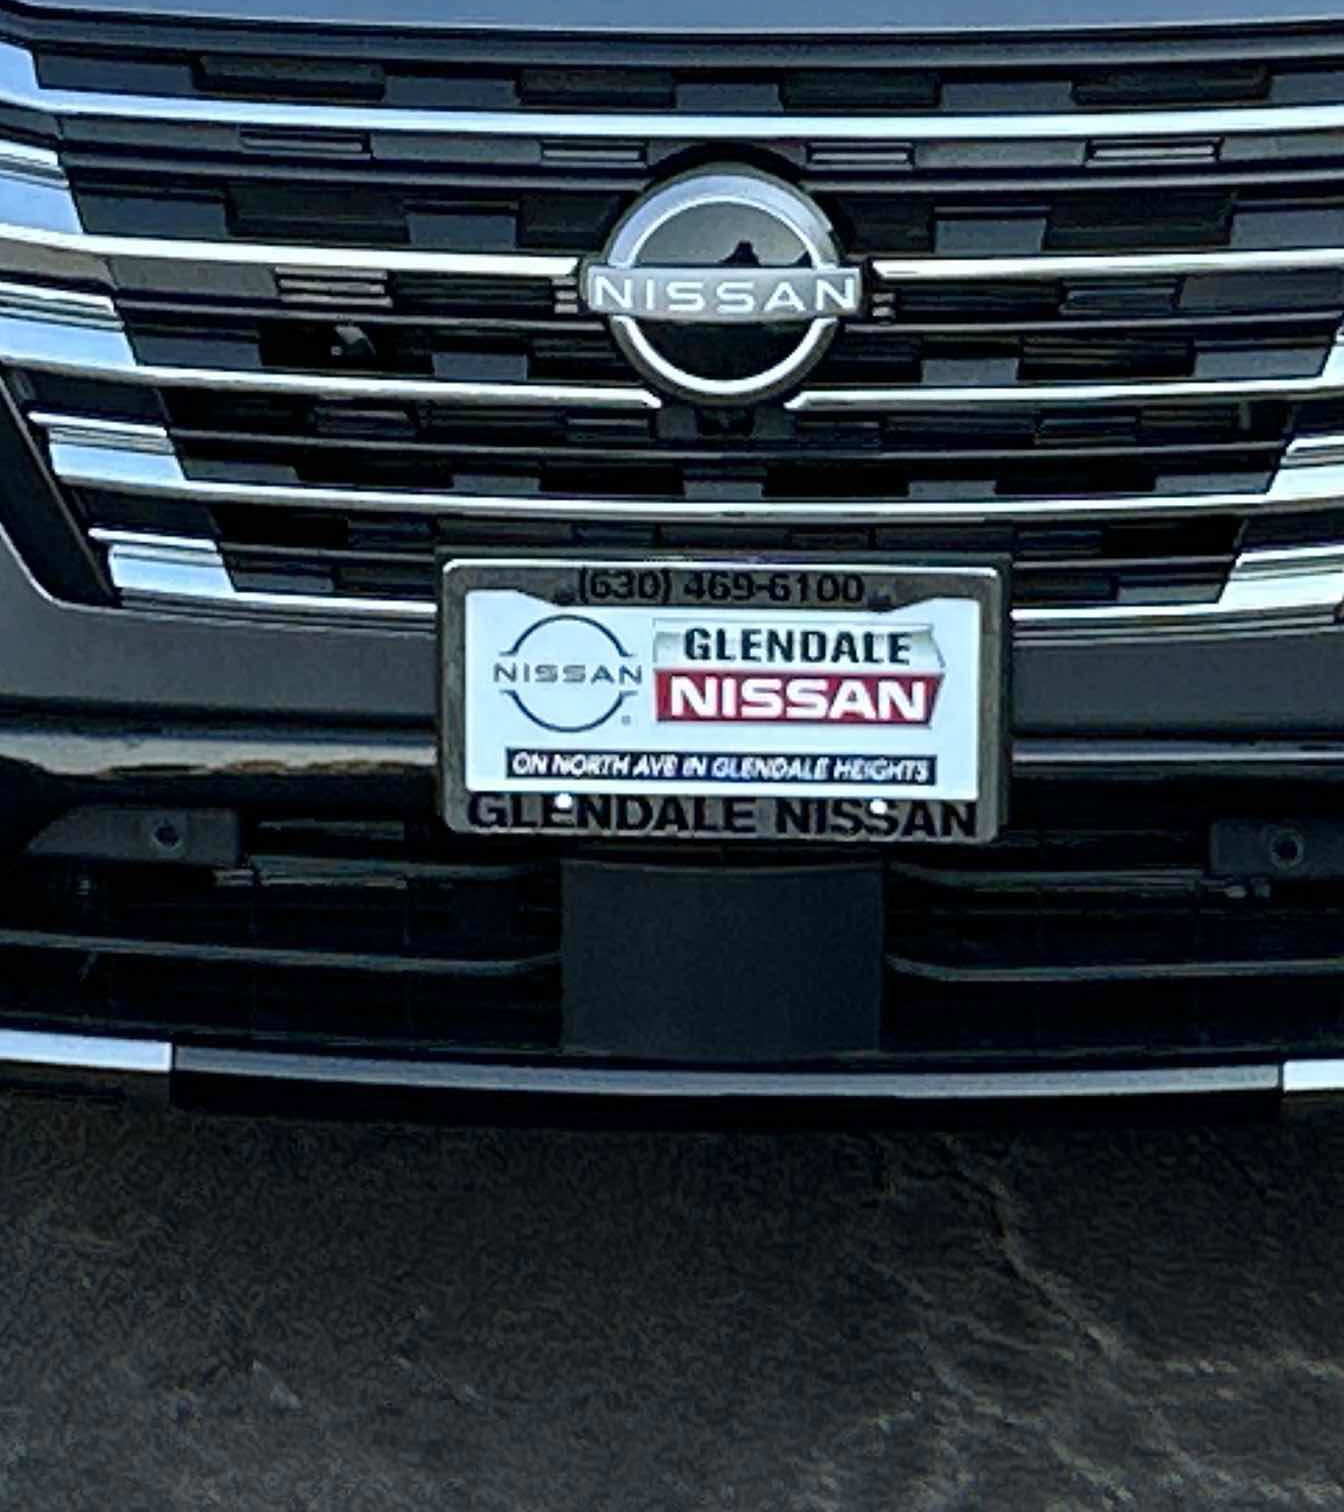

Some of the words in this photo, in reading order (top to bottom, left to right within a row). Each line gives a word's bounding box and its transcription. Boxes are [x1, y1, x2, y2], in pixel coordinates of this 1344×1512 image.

[592, 274, 857, 313] NISSAN
[577, 568, 671, 604] (630)
[684, 570, 865, 603] 469-6100
[684, 627, 911, 666] GLENDALE
[494, 663, 642, 685] NISSAN
[670, 676, 925, 721] NISSAN
[512, 752, 547, 775] ON
[554, 753, 630, 777] NORTH
[633, 754, 677, 777] AVE
[682, 755, 706, 778] IN
[711, 756, 828, 780] GLENDALE
[833, 758, 929, 782] HEIGHTS
[469, 792, 754, 832] GLENDALE
[773, 797, 977, 837] NISSAN
